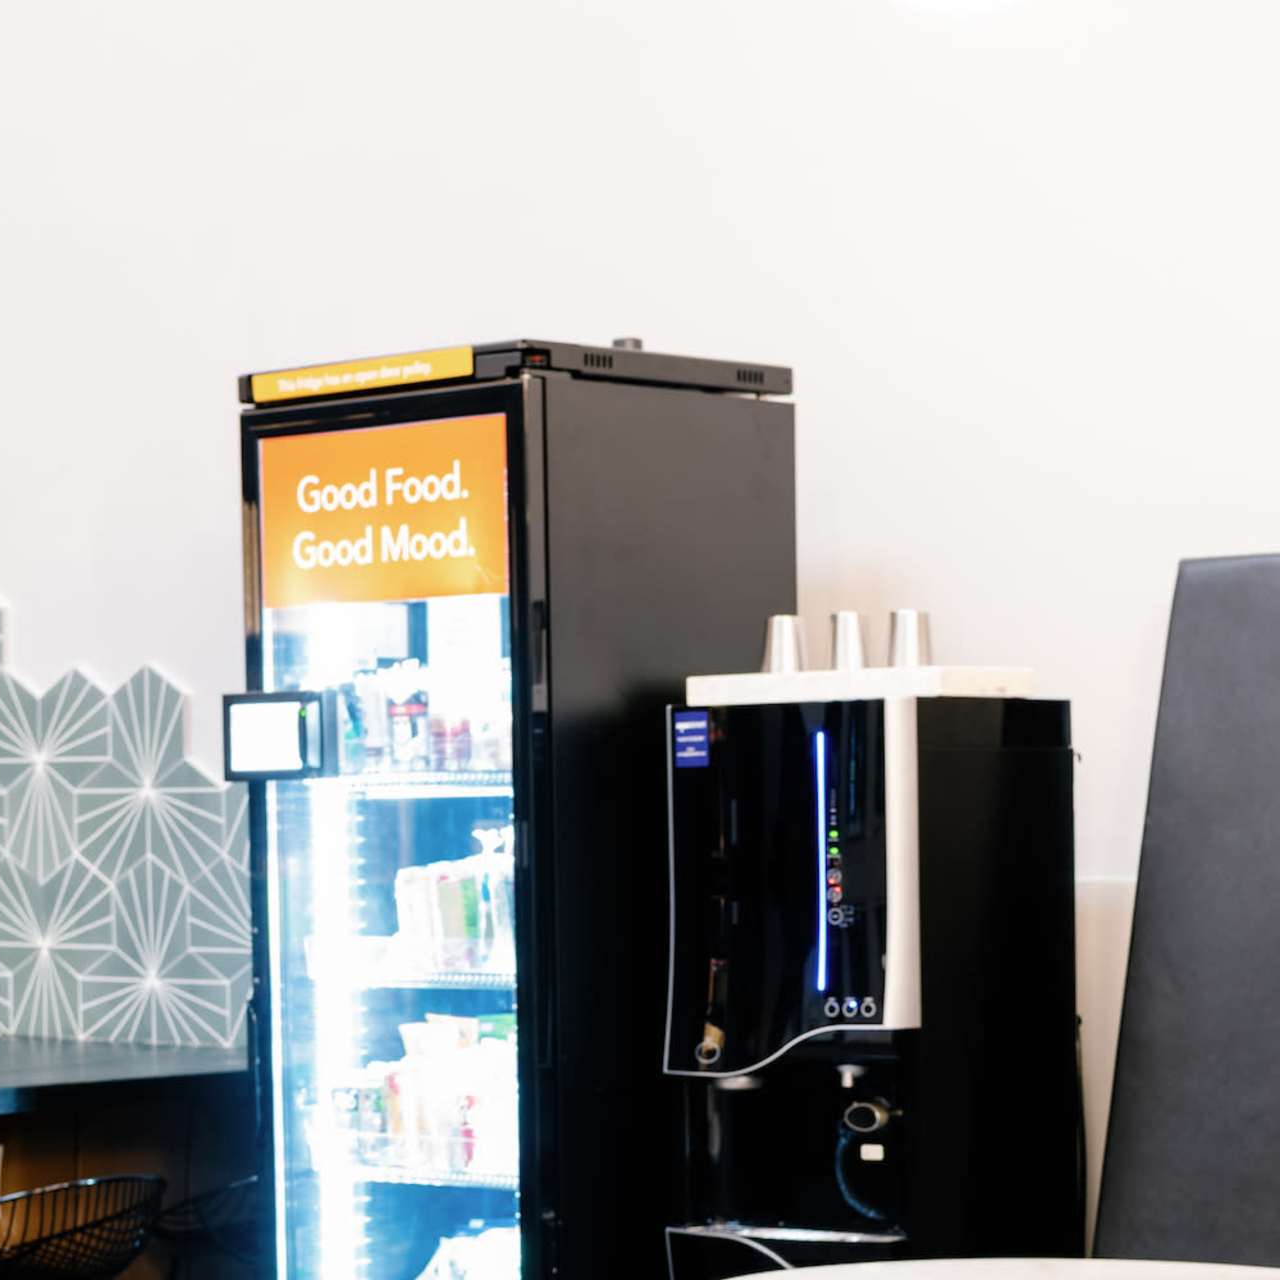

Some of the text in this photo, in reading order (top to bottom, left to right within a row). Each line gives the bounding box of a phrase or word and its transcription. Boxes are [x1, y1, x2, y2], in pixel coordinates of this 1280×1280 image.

[296, 459, 469, 513] Good Food.
[292, 516, 476, 570] Good Mood.
